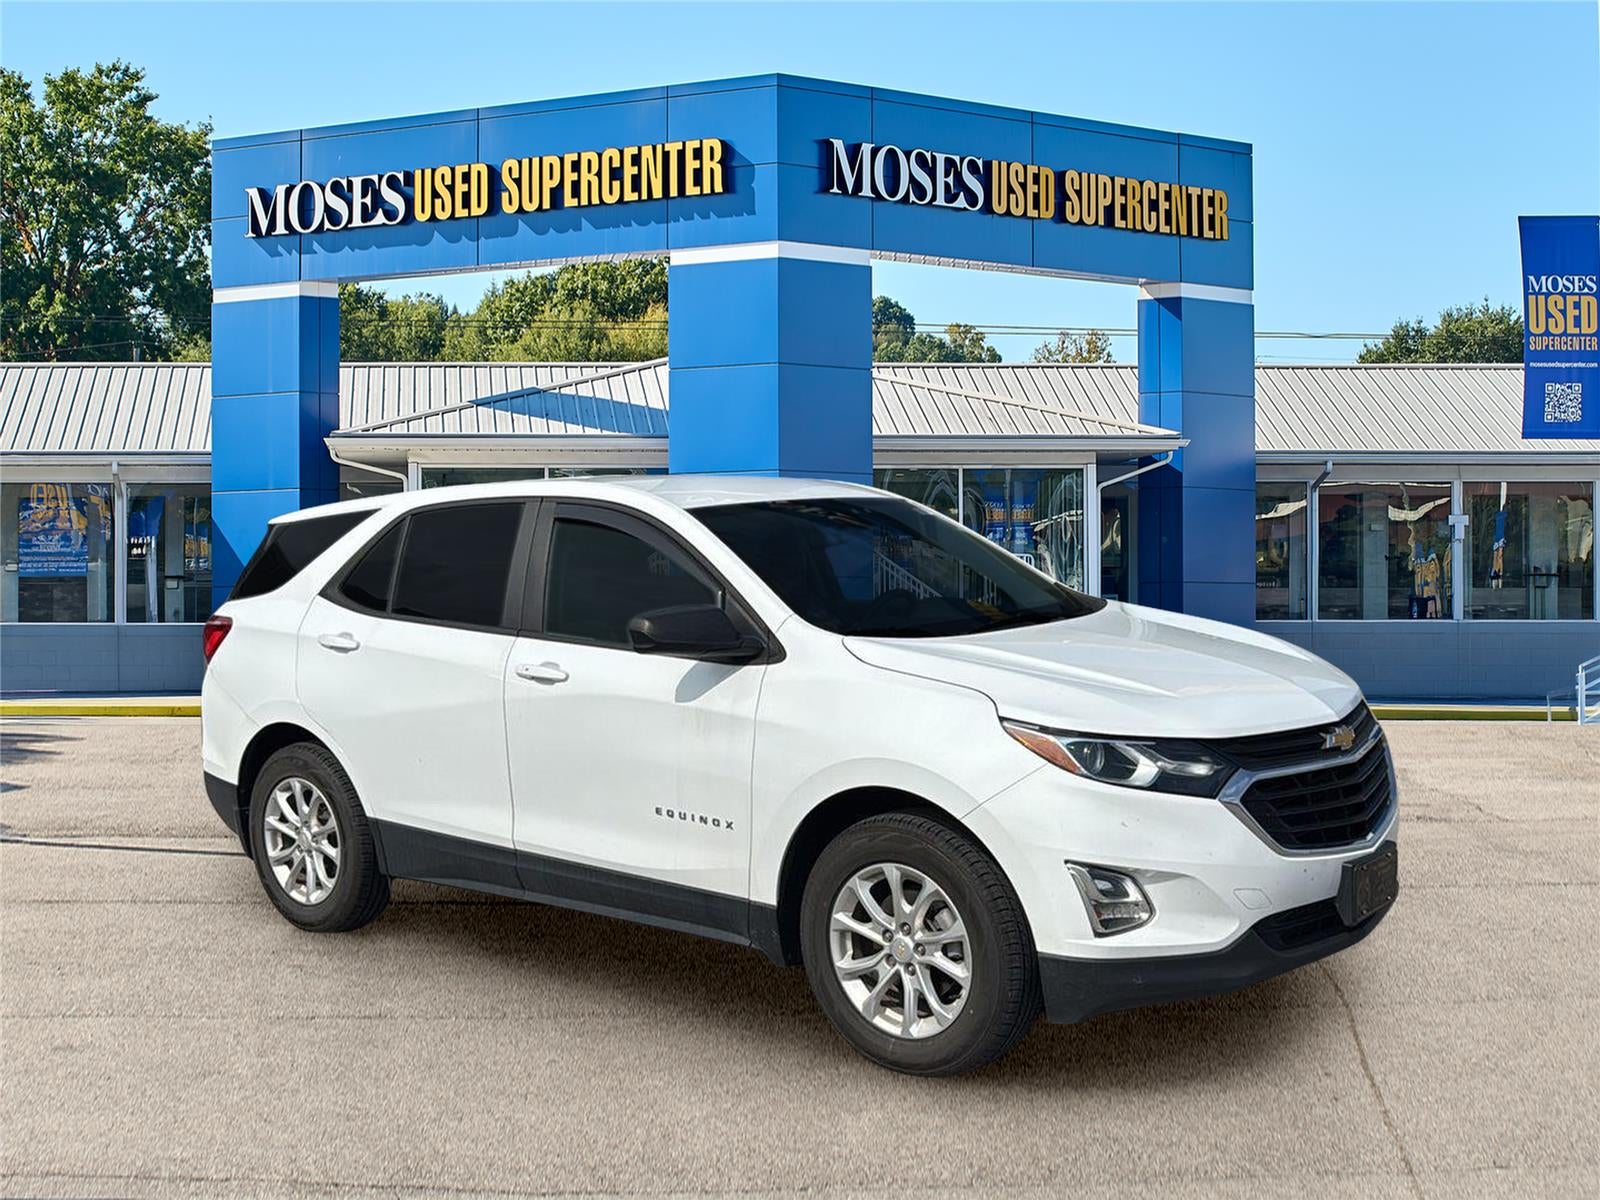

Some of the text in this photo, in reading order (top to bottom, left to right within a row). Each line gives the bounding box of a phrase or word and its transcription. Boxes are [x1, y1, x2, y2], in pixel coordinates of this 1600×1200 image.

[244, 138, 724, 239] MOSES USED SUPERCENTER
[829, 138, 1230, 240] MOSES USED SUPERCENTER
[1527, 275, 1597, 293] MOSES
[1528, 295, 1598, 335] USED
[1529, 336, 1598, 351] SUPERCENTER
[655, 806, 734, 831] EQUINOX
